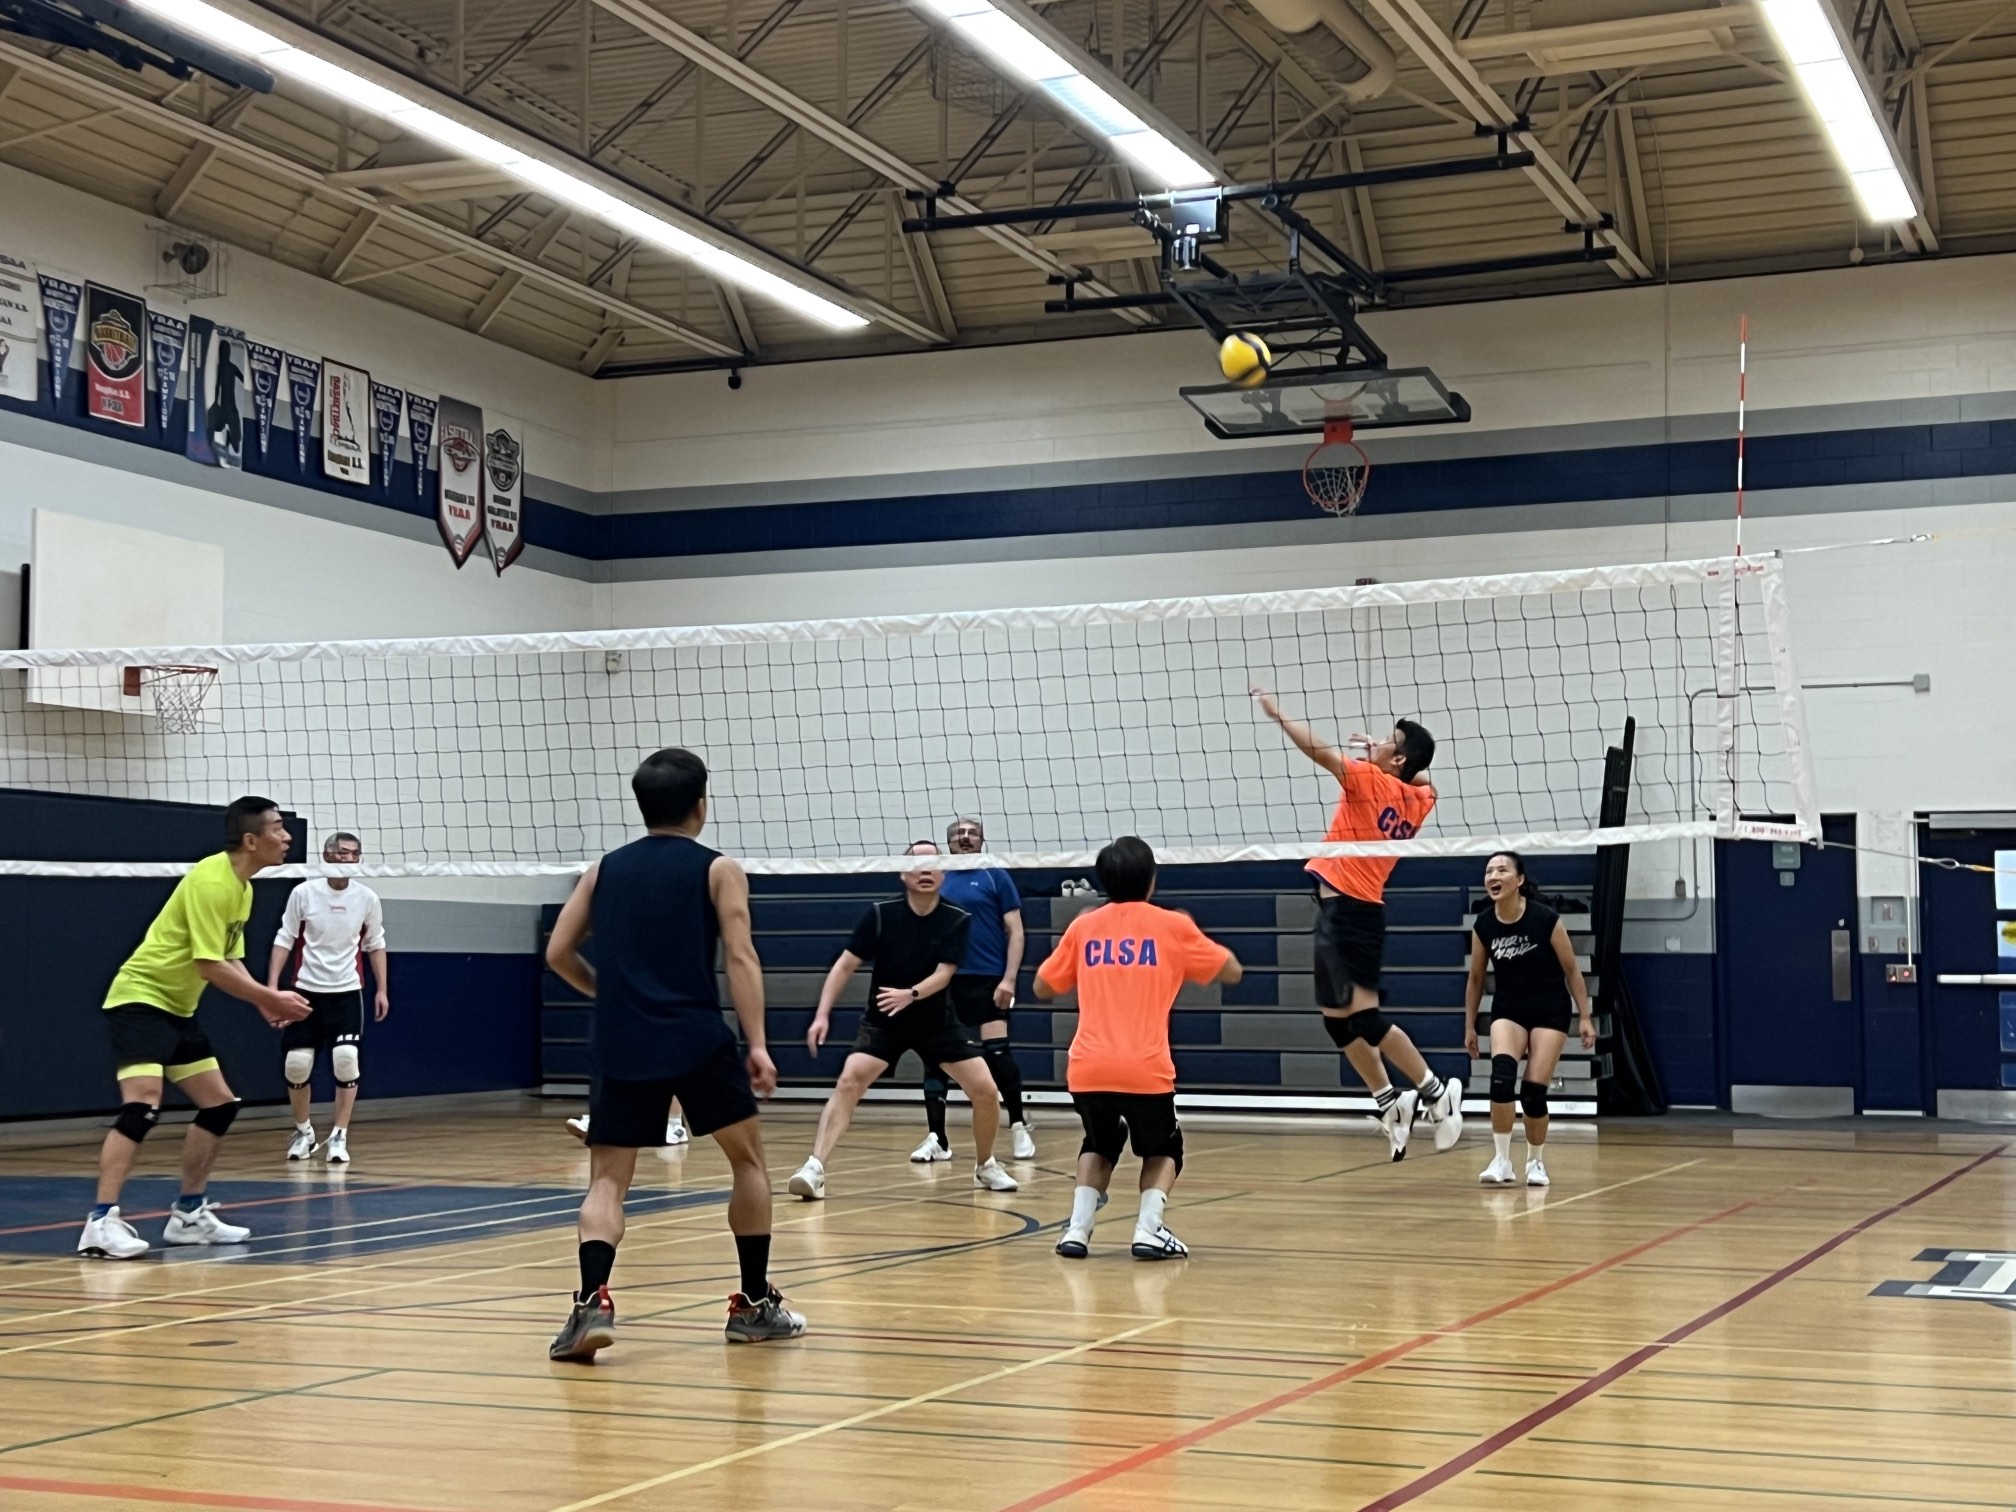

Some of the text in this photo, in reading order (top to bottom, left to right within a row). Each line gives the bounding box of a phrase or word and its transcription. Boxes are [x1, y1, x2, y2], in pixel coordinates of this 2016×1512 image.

[150, 313, 185, 331] YRAA
[247, 342, 280, 359] YRAA
[287, 356, 318, 372] YRAA
[1085, 938, 1157, 967] CLSA
